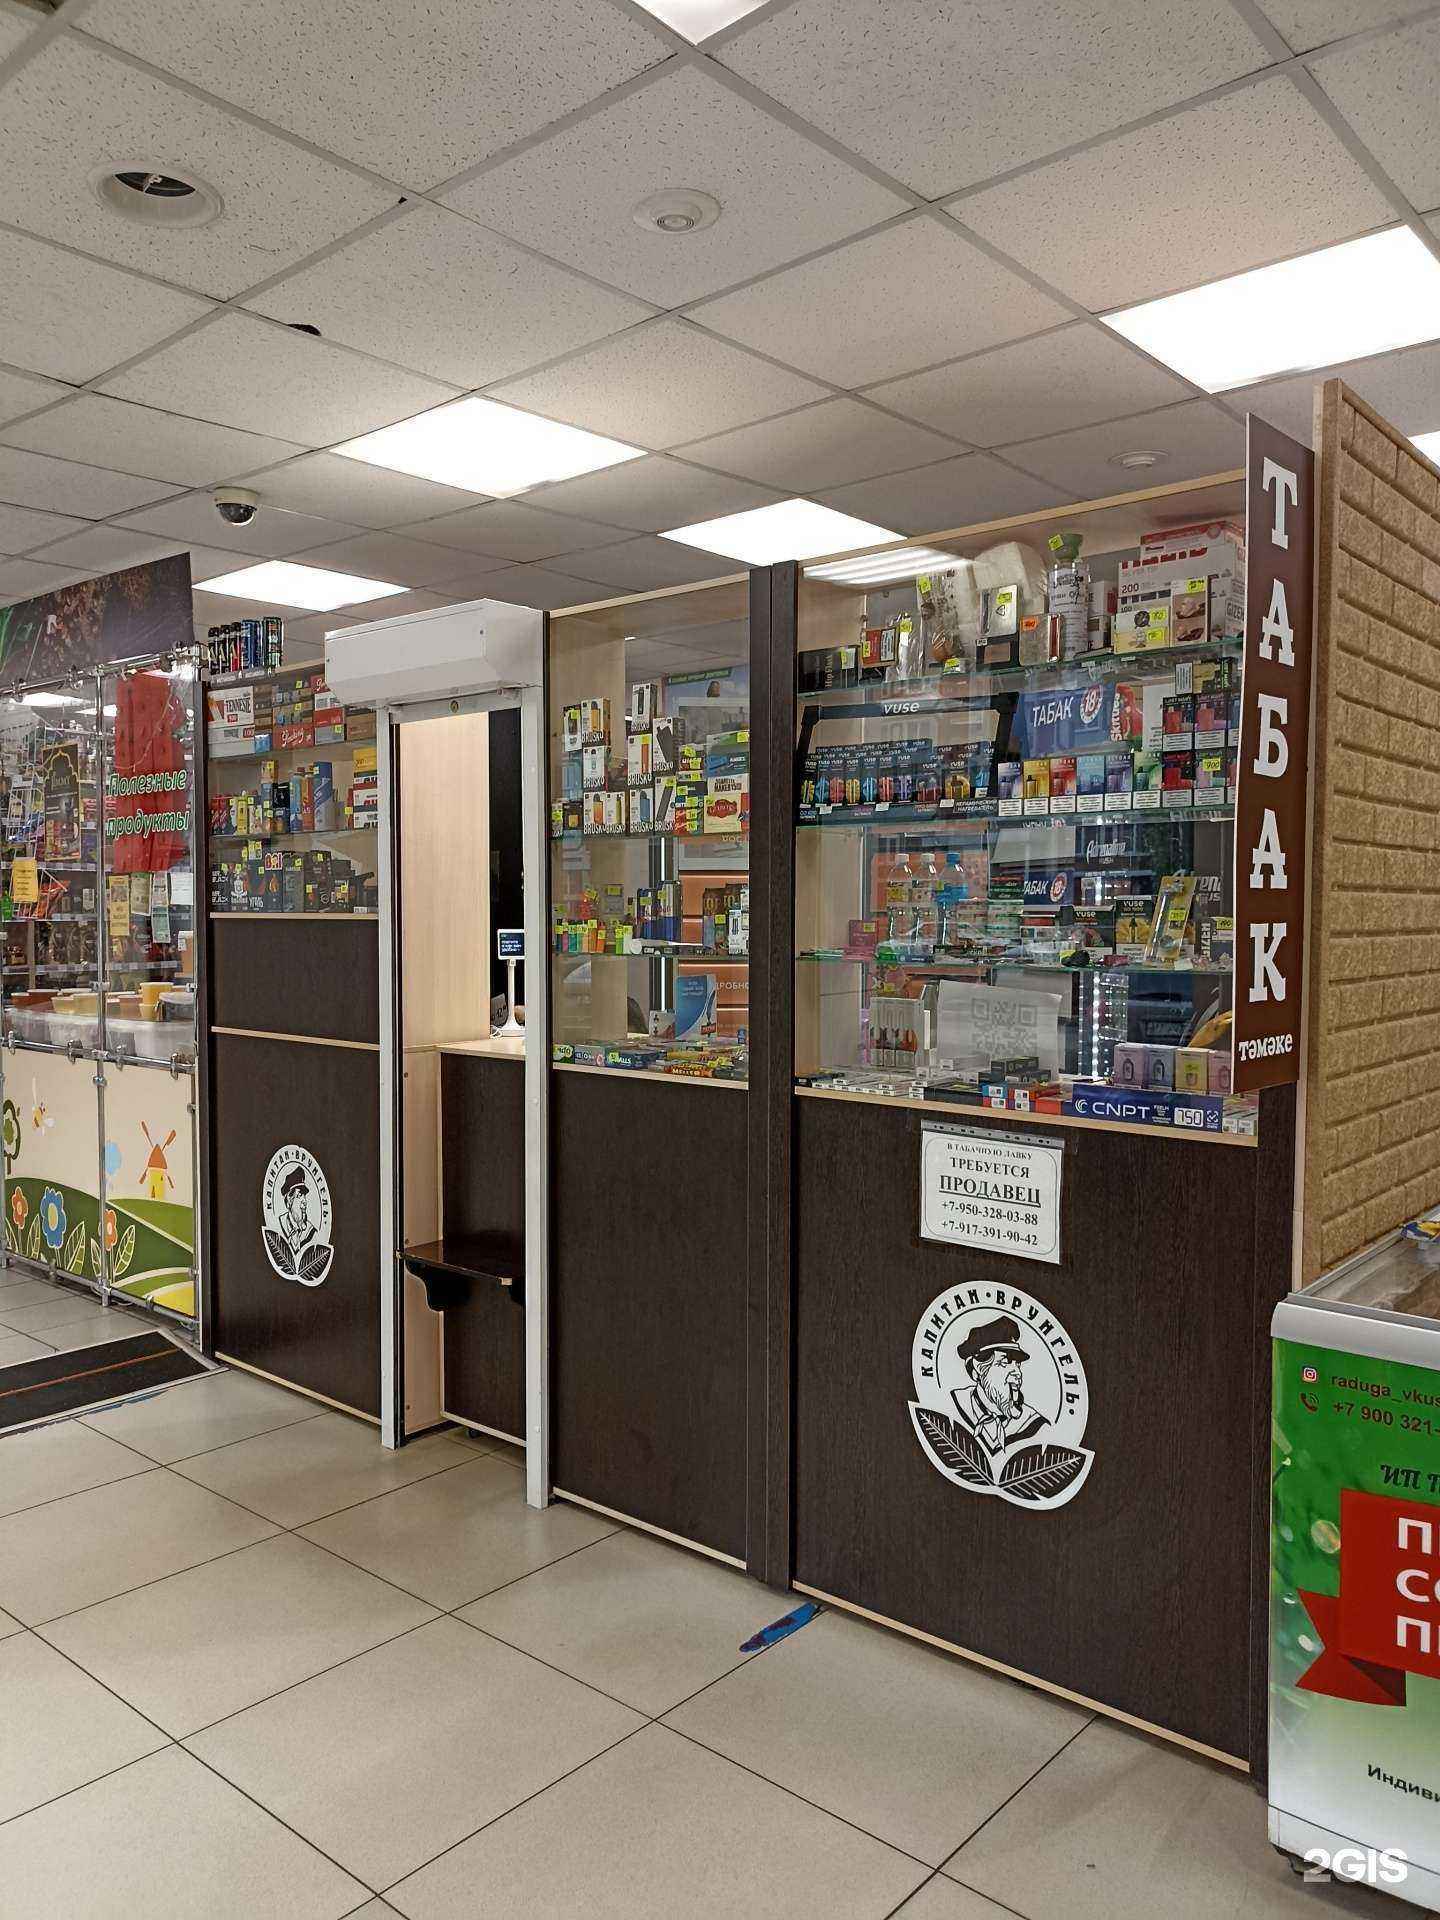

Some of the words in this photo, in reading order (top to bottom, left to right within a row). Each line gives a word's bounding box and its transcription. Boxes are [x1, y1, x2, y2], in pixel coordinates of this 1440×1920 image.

[884, 702, 920, 714] vuse
[1033, 696, 1073, 727] ТАБАК
[1248, 456, 1299, 1003] ТАБАК
[108, 769, 187, 797] Полезные
[628, 773, 652, 786] BRUSKO
[106, 808, 190, 841] продукты
[654, 820, 676, 832] BRUSK
[1123, 900, 1145, 908] vuse
[1092, 1102, 1150, 1119] CNPT
[1177, 1105, 1202, 1125] 750
[950, 1157, 1030, 1179] ТРЕБУЕТСЯ
[939, 1175, 1041, 1206] ПРОДАВЕЦ
[942, 1200, 1038, 1225] +7-950-328-03-88
[942, 1220, 1038, 1246] +7-917-391-90-42
[921, 1289, 980, 1377] КАПИТАН
[996, 1290, 1080, 1404] ВРУНГЕЛЬ
[1333, 1402, 1355, 1416] +7
[1361, 1406, 1394, 1426] 900
[1397, 1615, 1440, 1654] П
